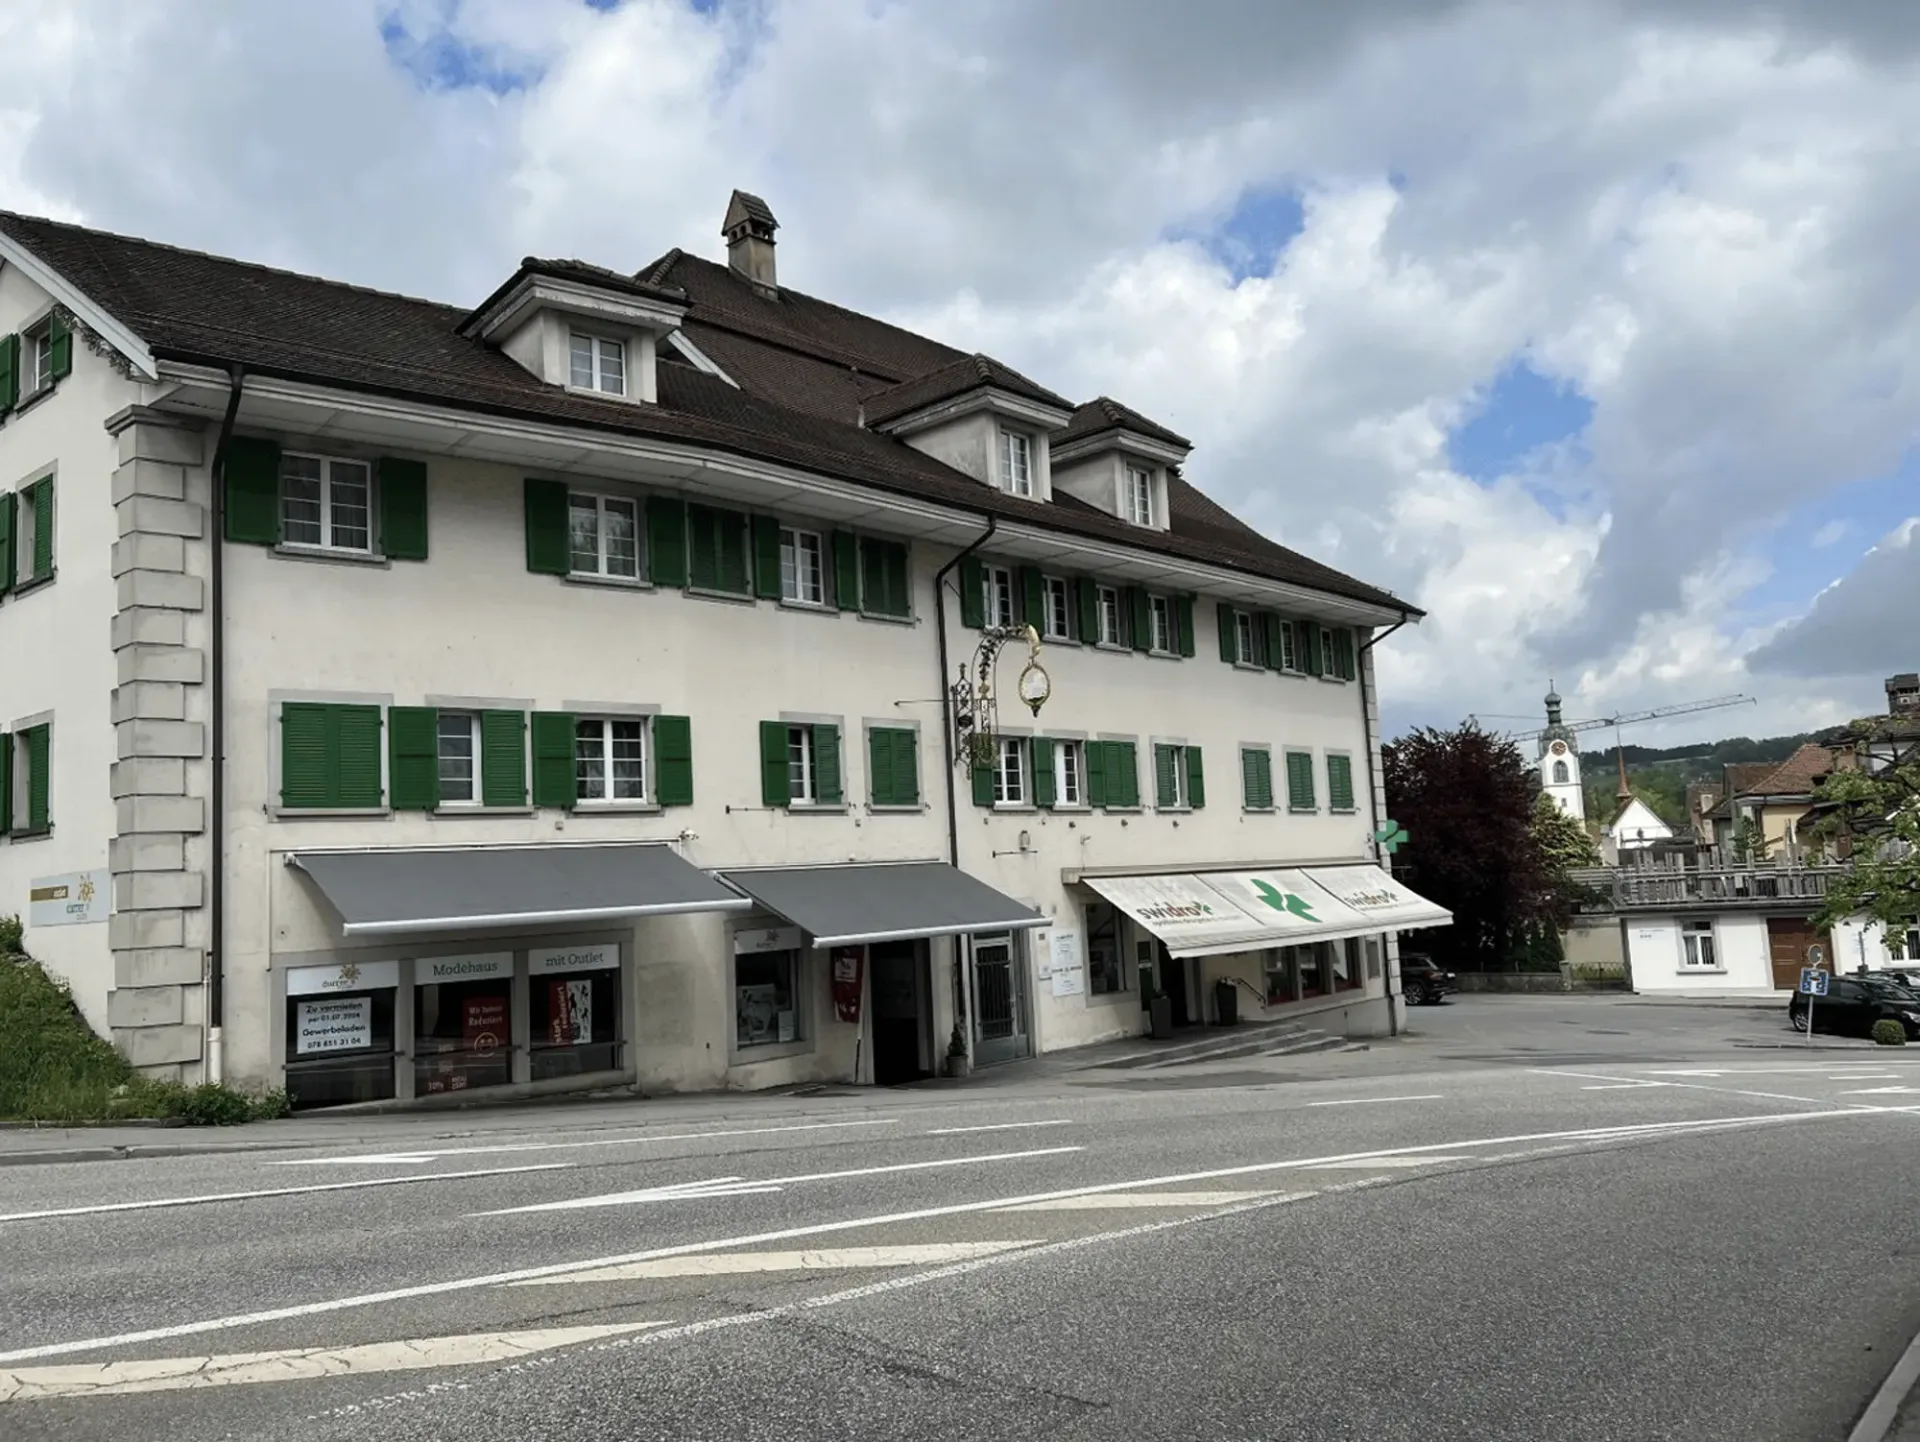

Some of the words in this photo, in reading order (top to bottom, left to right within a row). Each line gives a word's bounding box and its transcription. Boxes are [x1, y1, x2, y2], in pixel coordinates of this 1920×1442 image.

[1136, 901, 1201, 919] swidro
[546, 955, 566, 967] mit
[568, 952, 604, 965] Outlet
[433, 961, 499, 976] Modehaus
[306, 1005, 317, 1014] Zu
[320, 1002, 363, 1013] vermieten
[302, 1025, 366, 1036] Gewerbeladen
